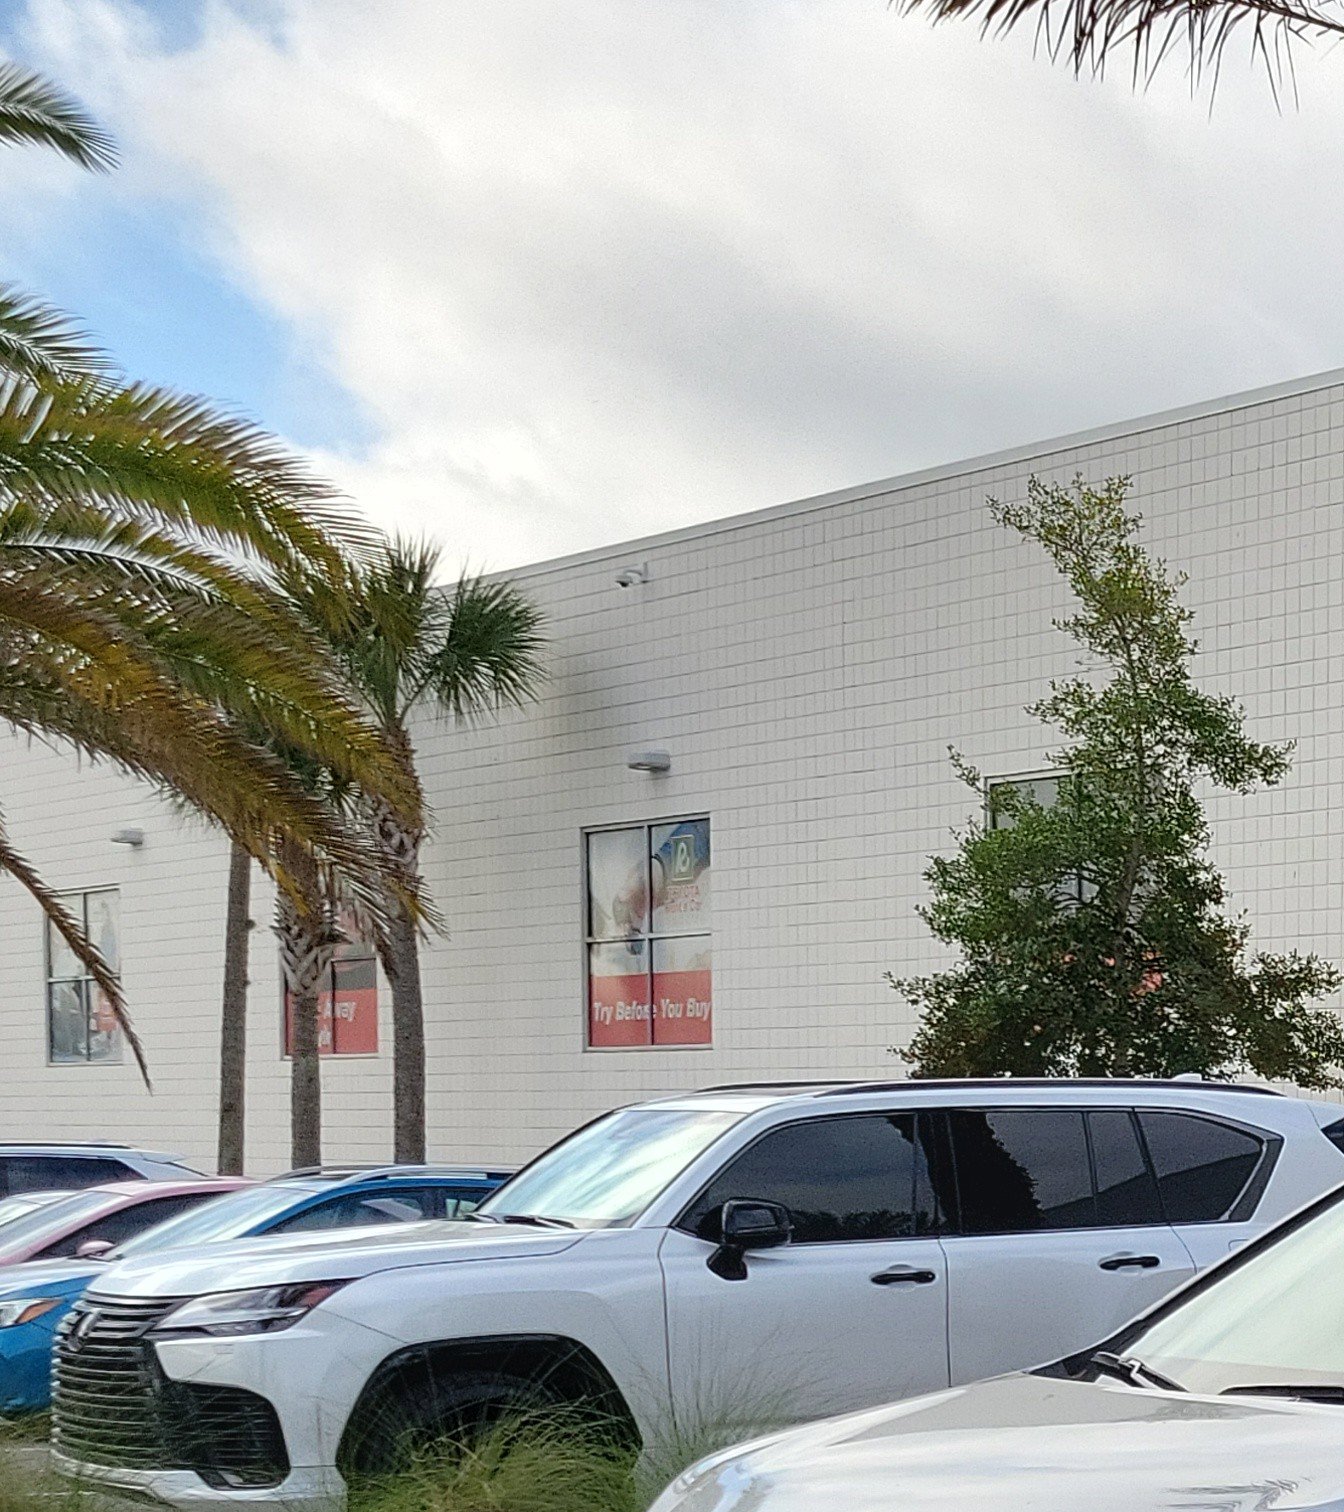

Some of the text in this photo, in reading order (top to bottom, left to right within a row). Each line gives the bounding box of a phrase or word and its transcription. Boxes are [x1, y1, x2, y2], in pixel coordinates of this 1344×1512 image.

[594, 997, 711, 1025] Try Before You Buy
